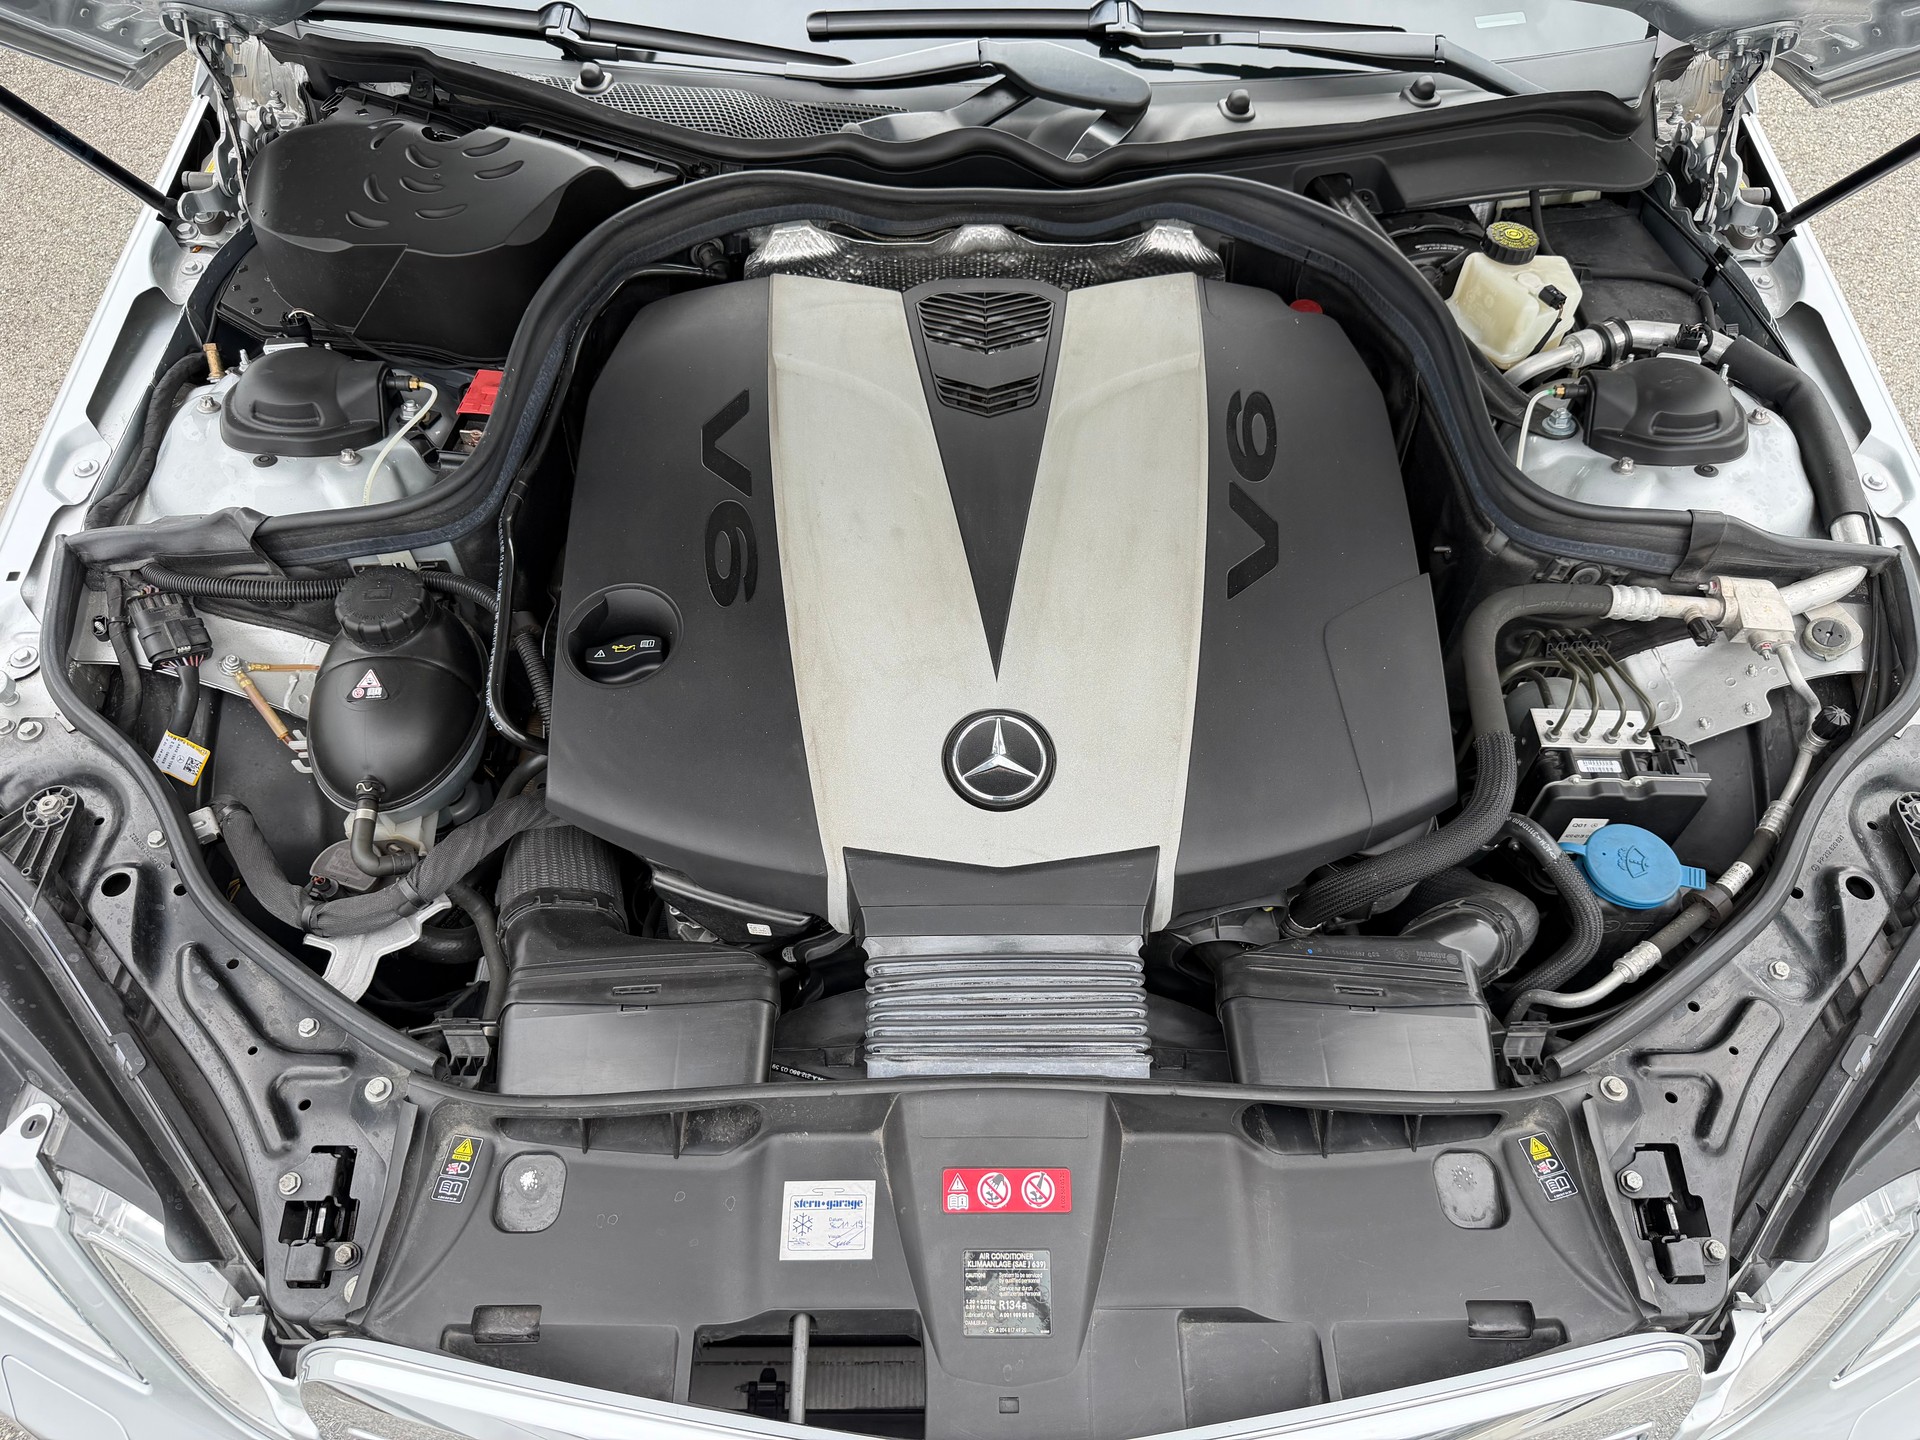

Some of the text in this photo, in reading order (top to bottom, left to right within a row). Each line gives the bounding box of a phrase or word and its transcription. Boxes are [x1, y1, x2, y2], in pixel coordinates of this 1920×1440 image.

[701, 388, 758, 608] V6
[1226, 389, 1279, 600] V6
[999, 1300, 1027, 1310] R134a
[1013, 1261, 1027, 1269] (SAE
[1032, 1261, 1047, 1269] 639)
